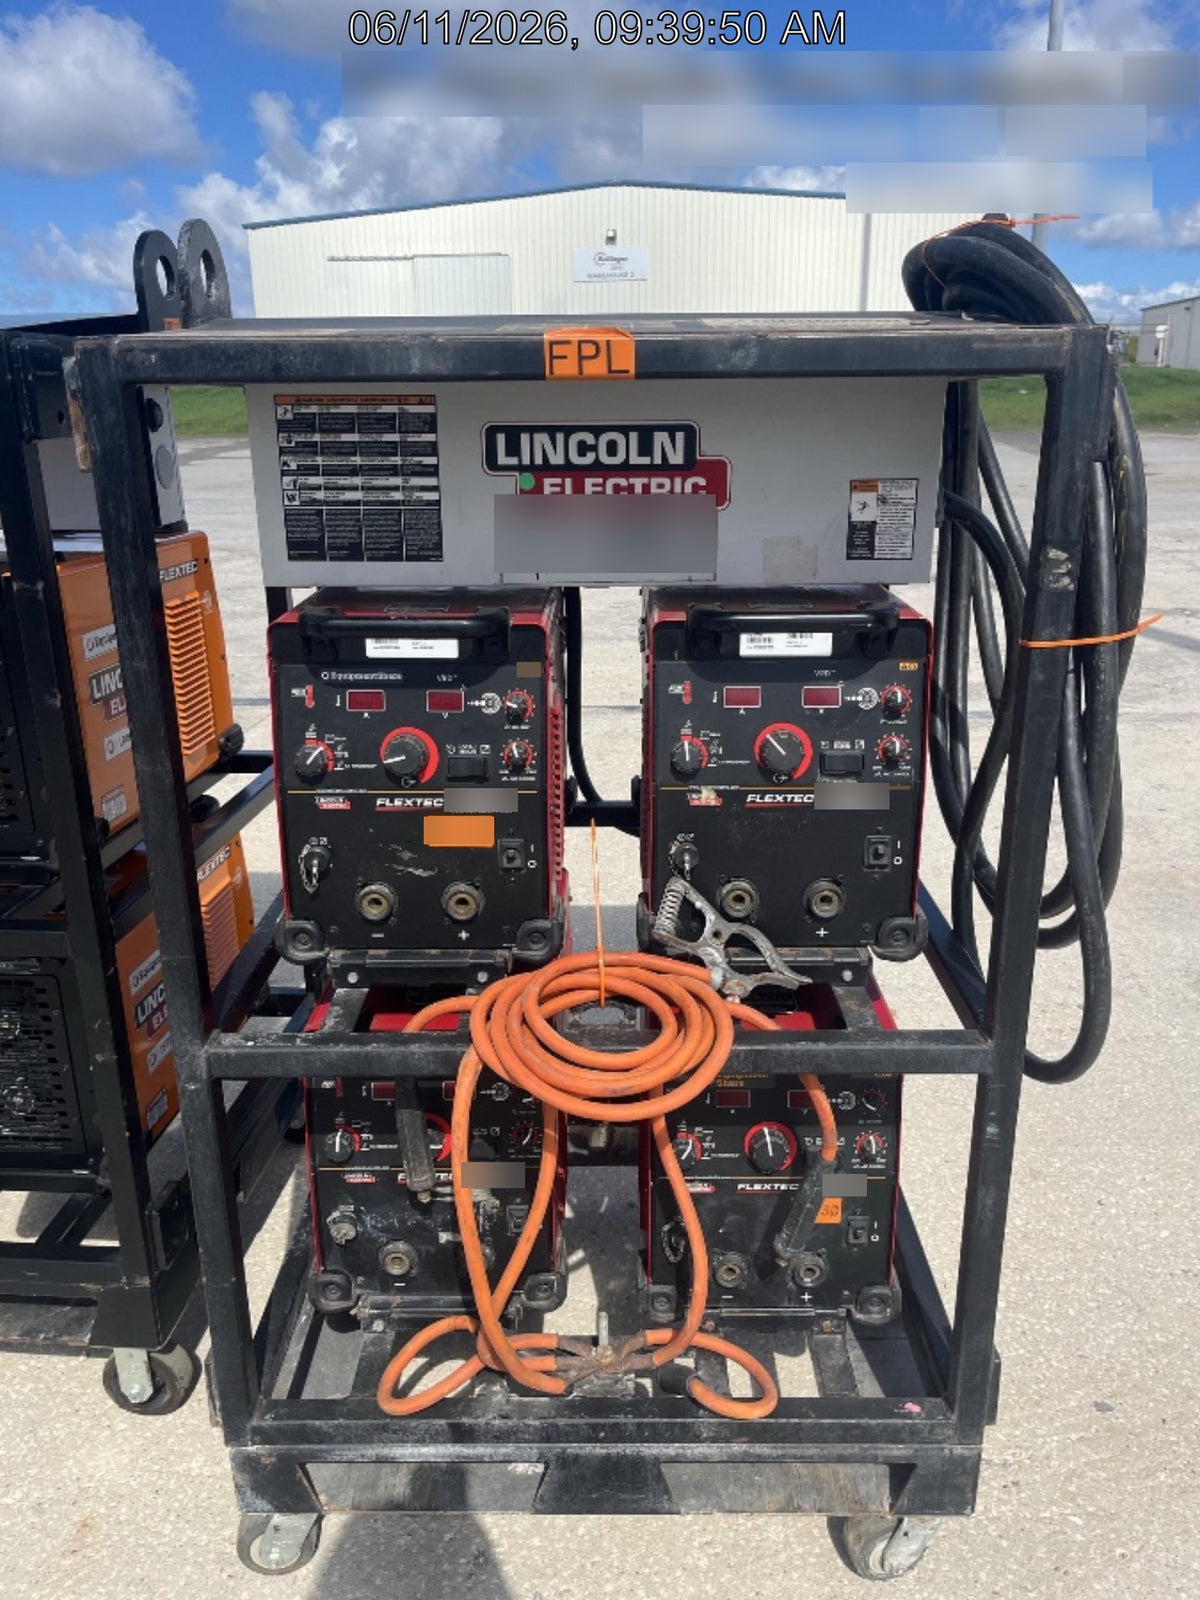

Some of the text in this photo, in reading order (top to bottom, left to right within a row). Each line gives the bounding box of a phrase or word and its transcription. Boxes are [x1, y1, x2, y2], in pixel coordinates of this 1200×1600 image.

[549, 339, 630, 376] FPL
[495, 431, 686, 466] LINCOLN
[375, 797, 444, 807] FLEXTEC
[745, 793, 815, 803] FLEXTEC
[736, 1183, 800, 1191] FLEXTEC
